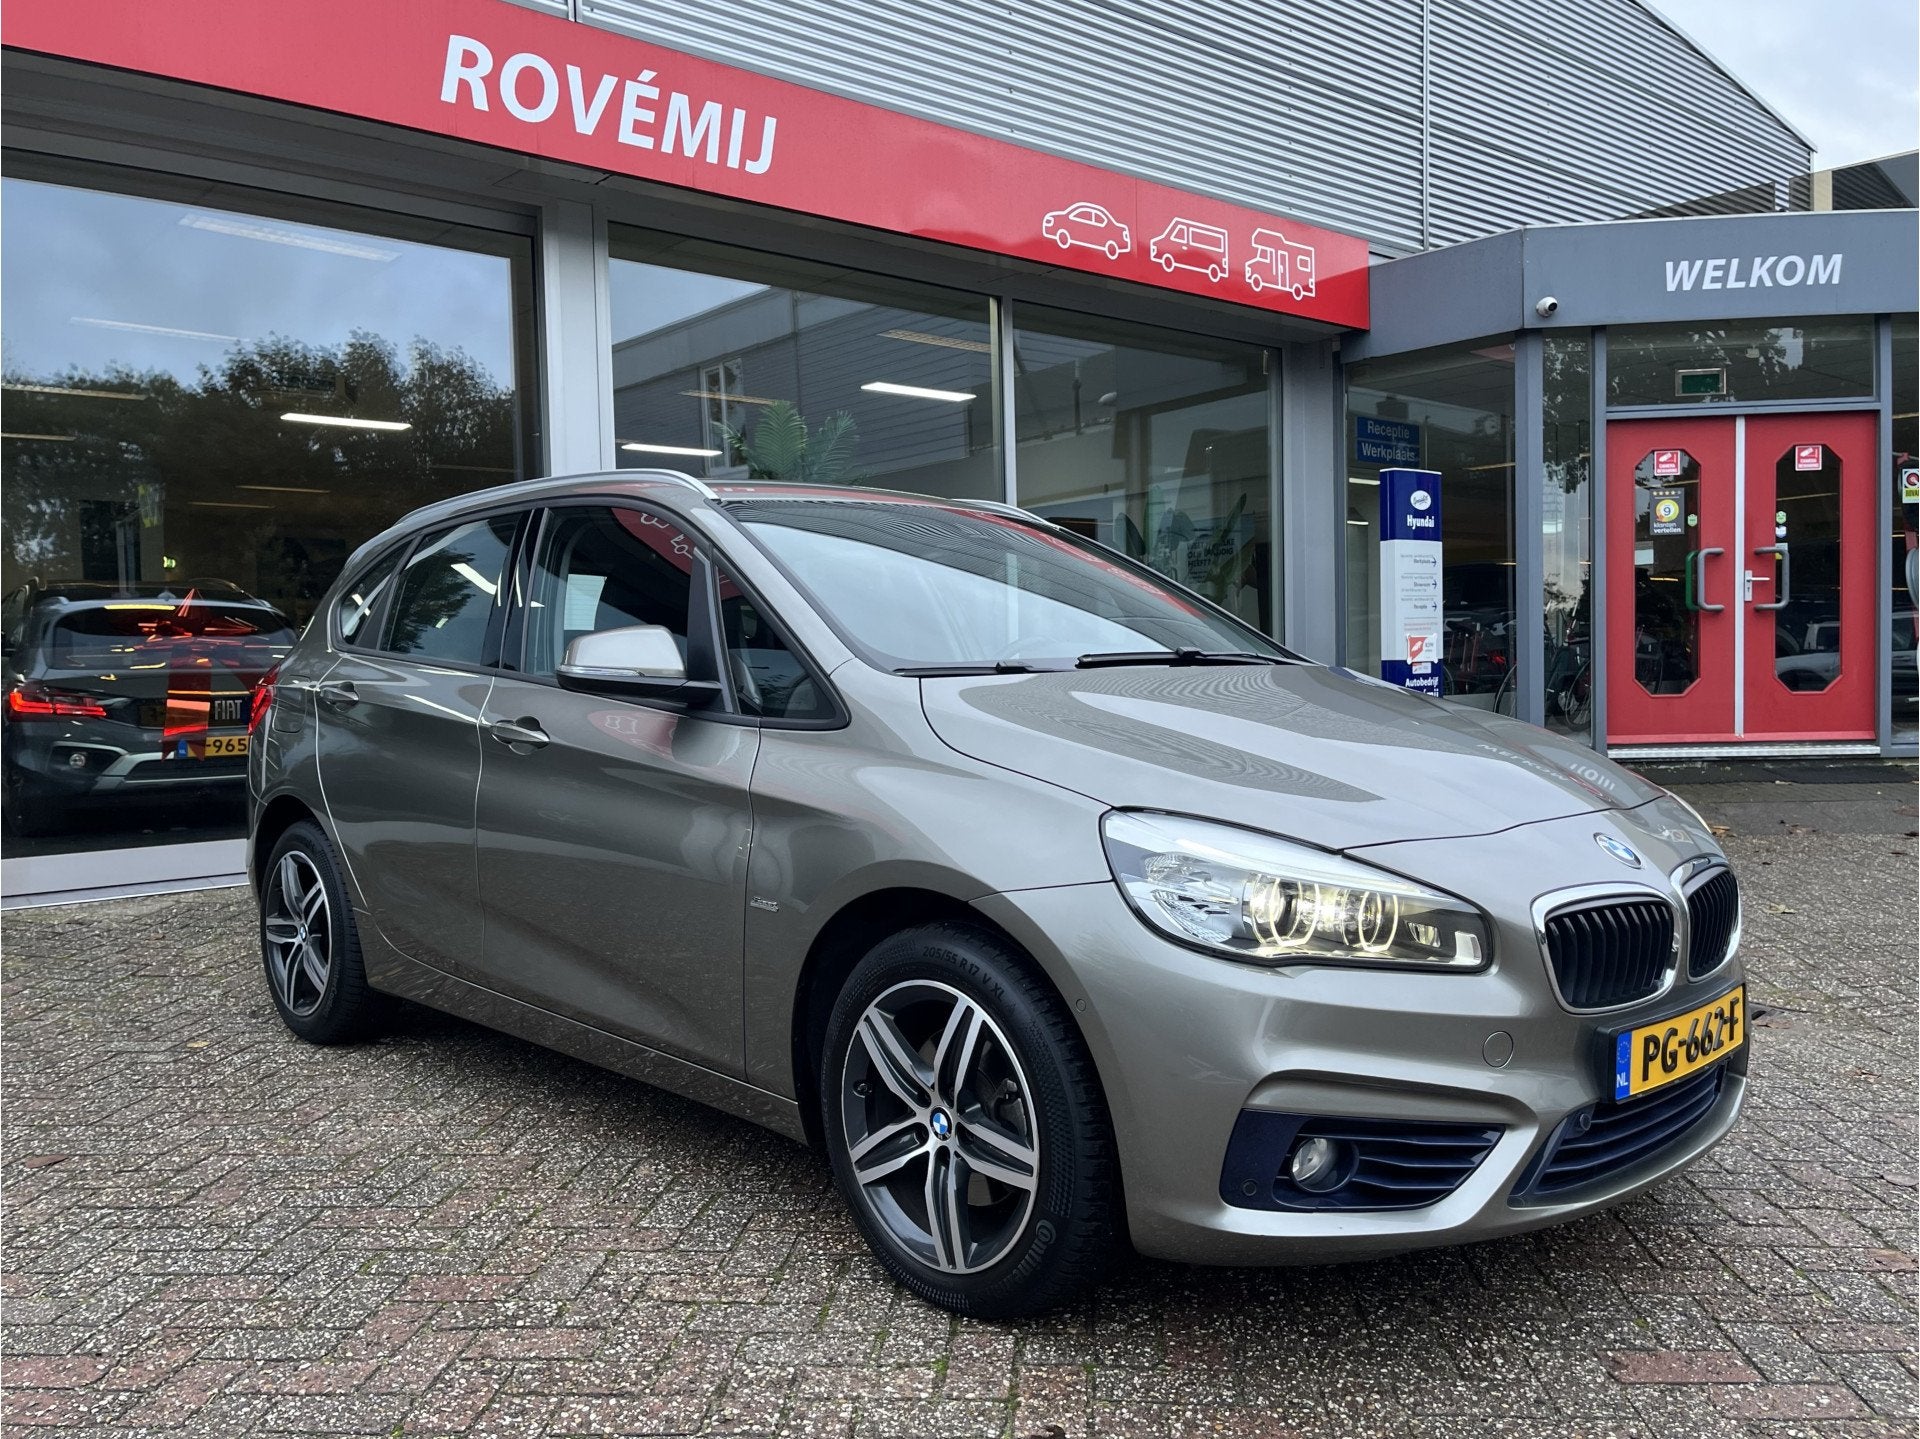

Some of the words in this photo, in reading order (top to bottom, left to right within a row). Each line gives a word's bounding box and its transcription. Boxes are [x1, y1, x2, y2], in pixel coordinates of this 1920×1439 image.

[440, 34, 777, 174] ROVÉMIJ
[1665, 253, 1843, 292] WELKOM
[1367, 420, 1410, 440] Receptie
[1361, 442, 1415, 461] Werkplaats
[1407, 514, 1435, 530] Hyundai
[1405, 676, 1439, 688] Autobedrijf
[214, 699, 243, 720] FIAT
[923, 946, 959, 965] 205/55
[1642, 996, 1740, 1082] PG-662-F
[1616, 1071, 1629, 1088] NL
